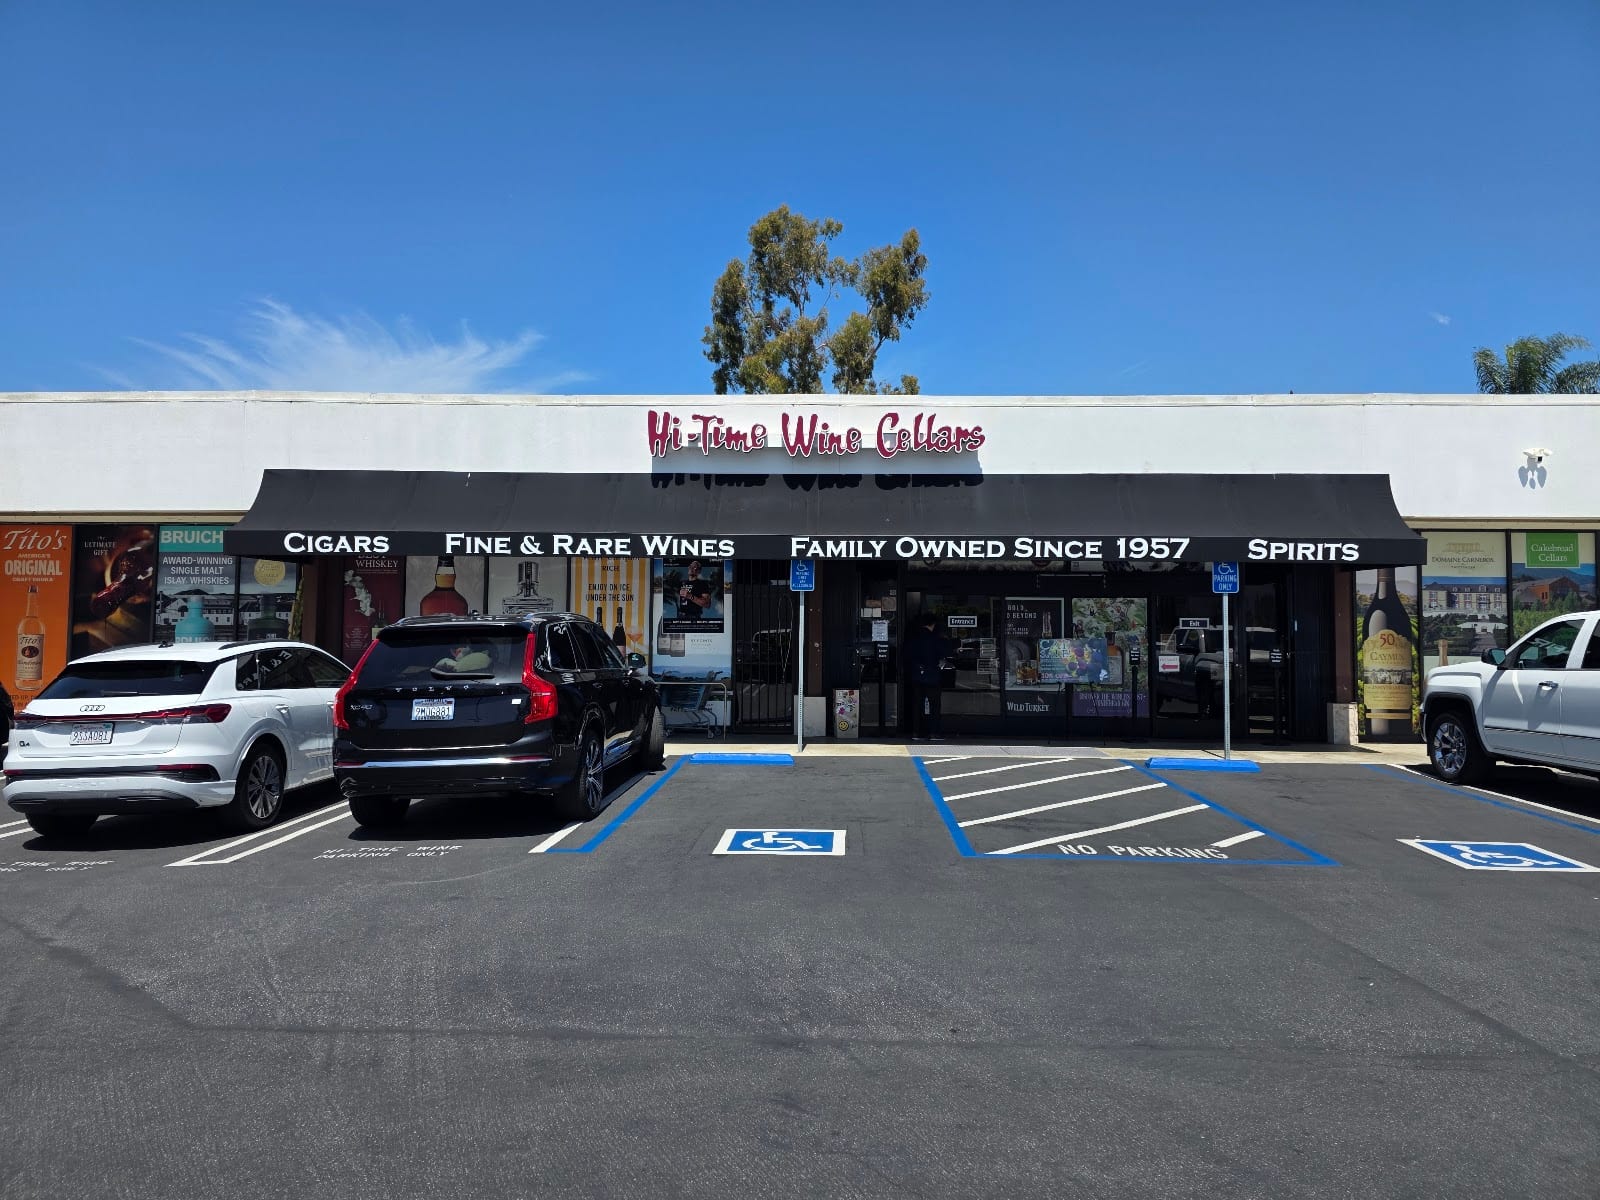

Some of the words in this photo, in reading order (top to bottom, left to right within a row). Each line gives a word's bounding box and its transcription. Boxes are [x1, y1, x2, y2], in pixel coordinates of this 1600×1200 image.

[648, 410, 768, 457] Hi-Time
[781, 412, 863, 457] Wine
[876, 412, 986, 458] Cellars
[3, 527, 68, 550] Tito's
[519, 535, 545, 555] &
[1116, 537, 1190, 559] 1957
[162, 556, 233, 565] AWARD-WINNING
[1538, 553, 1568, 562] Cellars
[5, 559, 63, 576] ORIGINAL
[355, 559, 399, 568] WHISKEY
[170, 566, 200, 575] SINGLE
[201, 566, 224, 575] MALT
[164, 576, 188, 585] ISLAY
[189, 576, 230, 585] WHISKIES
[1213, 574, 1238, 583] PARKING
[588, 584, 608, 592] ENJOY
[609, 584, 619, 592] ON
[620, 584, 631, 592] ICE
[1218, 583, 1233, 591] ONLY
[585, 594, 608, 602] UNDER
[608, 594, 621, 602] THE
[621, 594, 635, 602] SUN
[1379, 633, 1396, 647] 50
[1056, 844, 1098, 855] NO
[1108, 845, 1229, 859] PARKING
